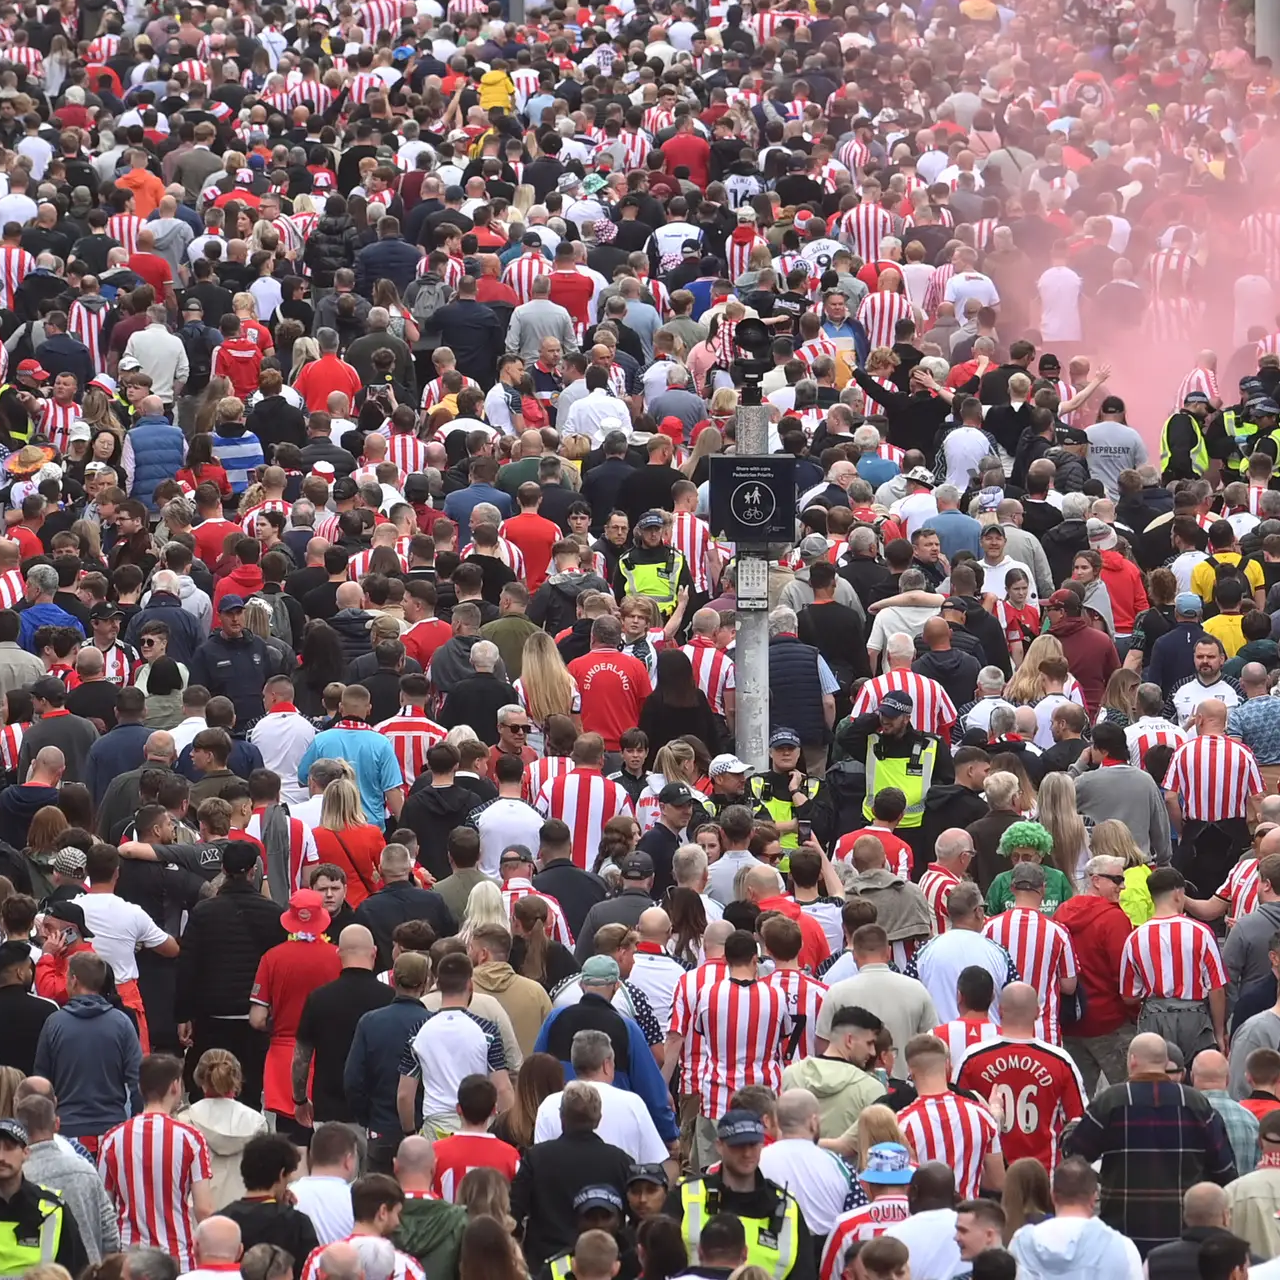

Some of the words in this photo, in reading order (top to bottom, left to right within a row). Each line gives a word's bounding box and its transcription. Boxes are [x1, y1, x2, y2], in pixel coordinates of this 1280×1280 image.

[1090, 445, 1130, 455] REPRESENT
[582, 662, 631, 691] SUNDERLAND
[980, 1054, 1054, 1087] PROMOTED
